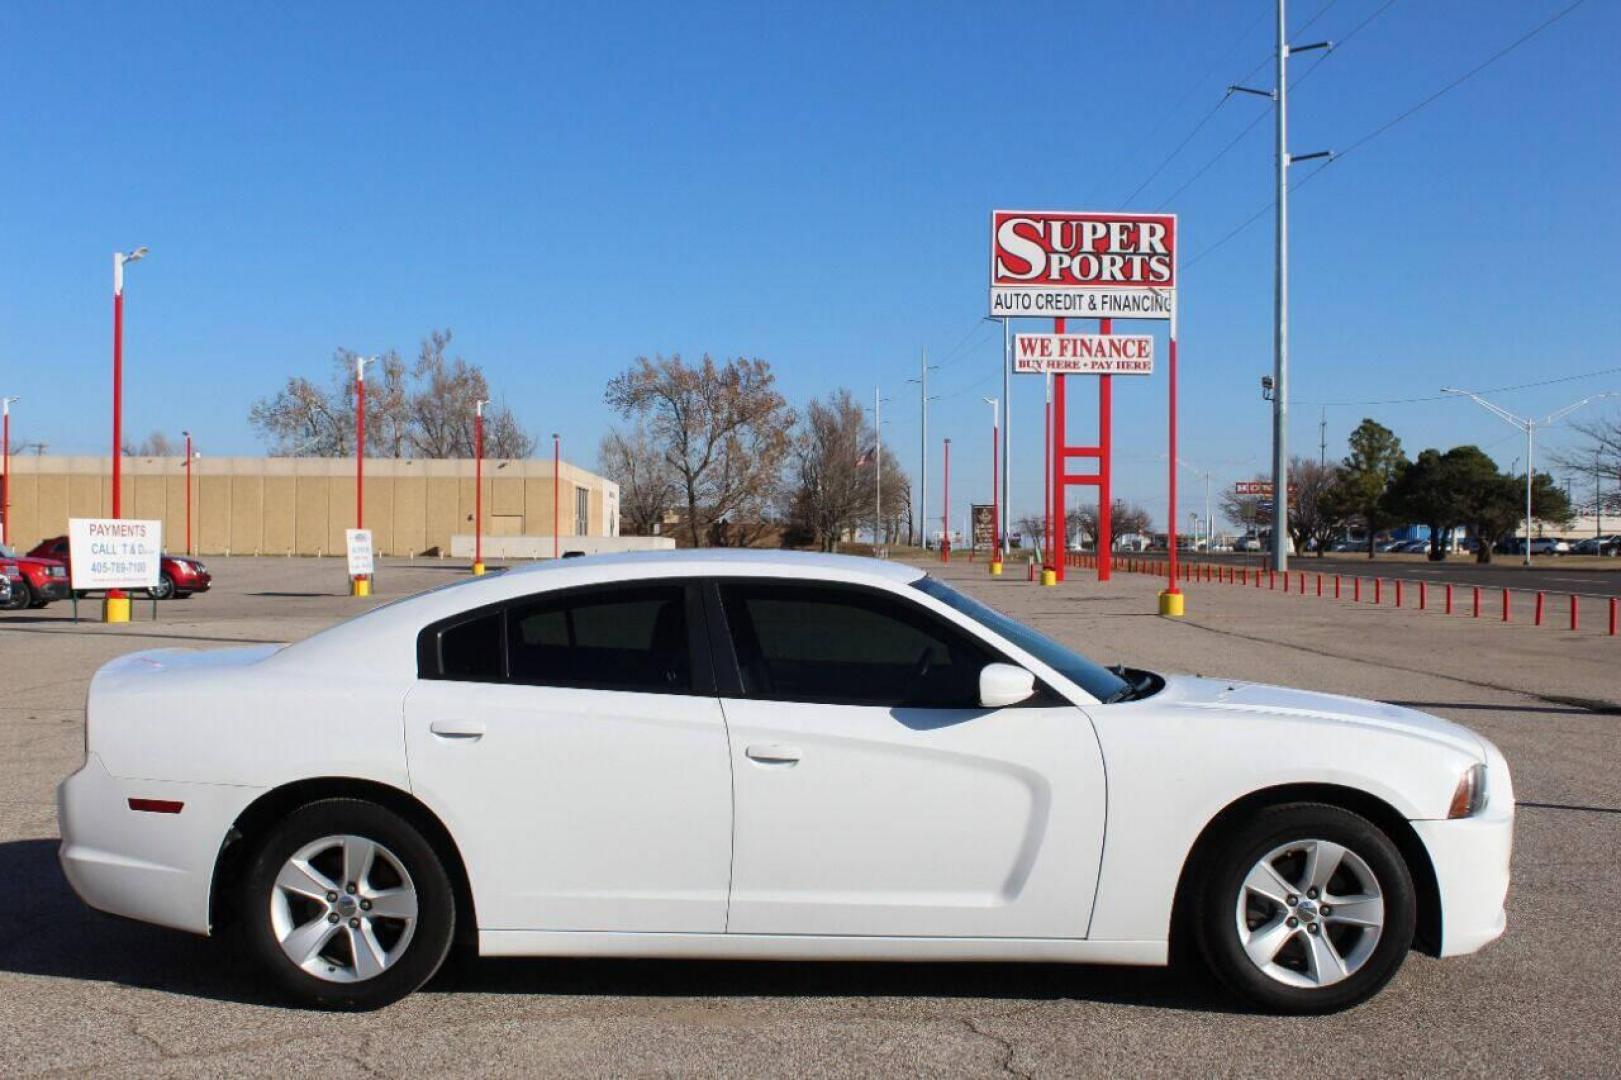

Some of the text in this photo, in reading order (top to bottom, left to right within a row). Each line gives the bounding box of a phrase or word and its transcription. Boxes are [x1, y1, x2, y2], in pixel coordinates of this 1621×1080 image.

[994, 293, 1171, 313] AUTO CREDIT & FINANCING
[1019, 337, 1150, 359] WE FINANCE
[1018, 360, 1150, 370] BUY HERE PAY HERE
[89, 523, 146, 537] PAYMENTS
[91, 543, 117, 555] CALL
